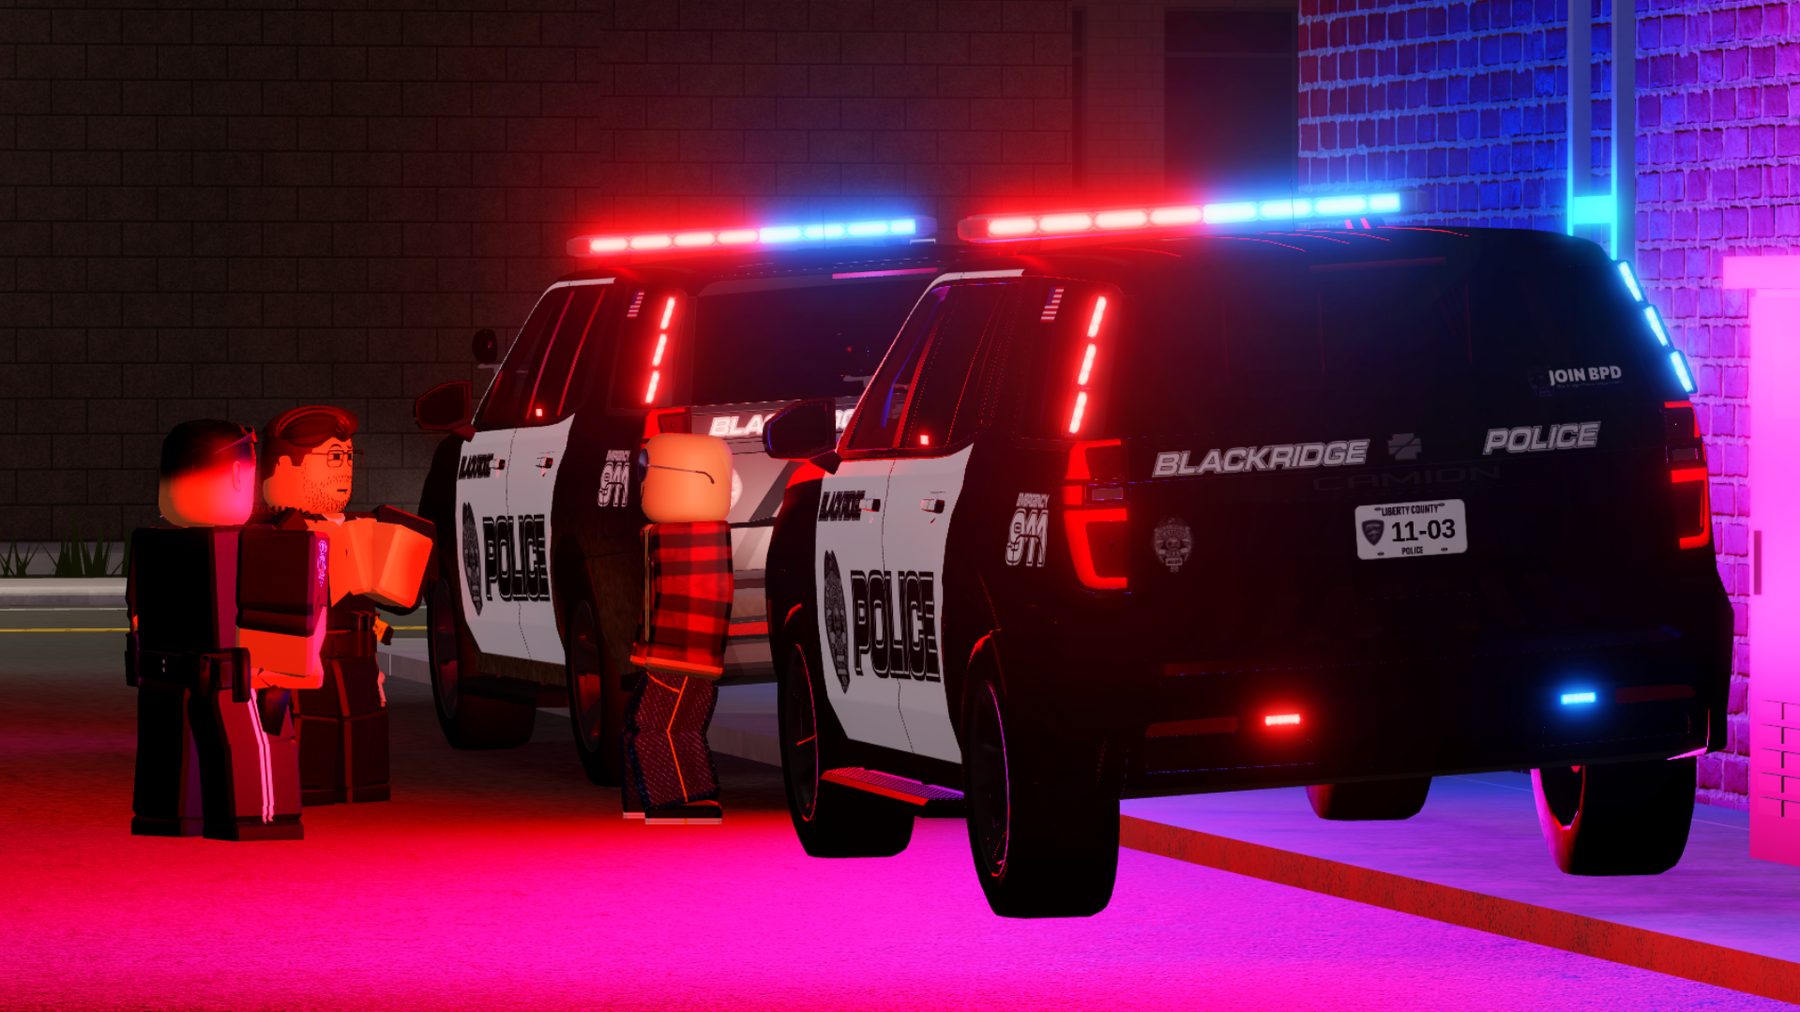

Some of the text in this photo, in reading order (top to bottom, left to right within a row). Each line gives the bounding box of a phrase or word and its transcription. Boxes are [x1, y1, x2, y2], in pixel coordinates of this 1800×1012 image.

[1548, 367, 1587, 387] JOIN
[1588, 365, 1622, 381] BPD
[1151, 420, 1602, 479] BLACKRIDGE POLICE
[598, 462, 631, 507] 911
[1381, 504, 1439, 516] LIBERTY COUNTY
[1391, 519, 1456, 542] 11-03
[482, 514, 551, 601] POLICE
[1004, 508, 1049, 568] 911
[1401, 546, 1424, 555] POLICE
[850, 570, 941, 682] POLICE
